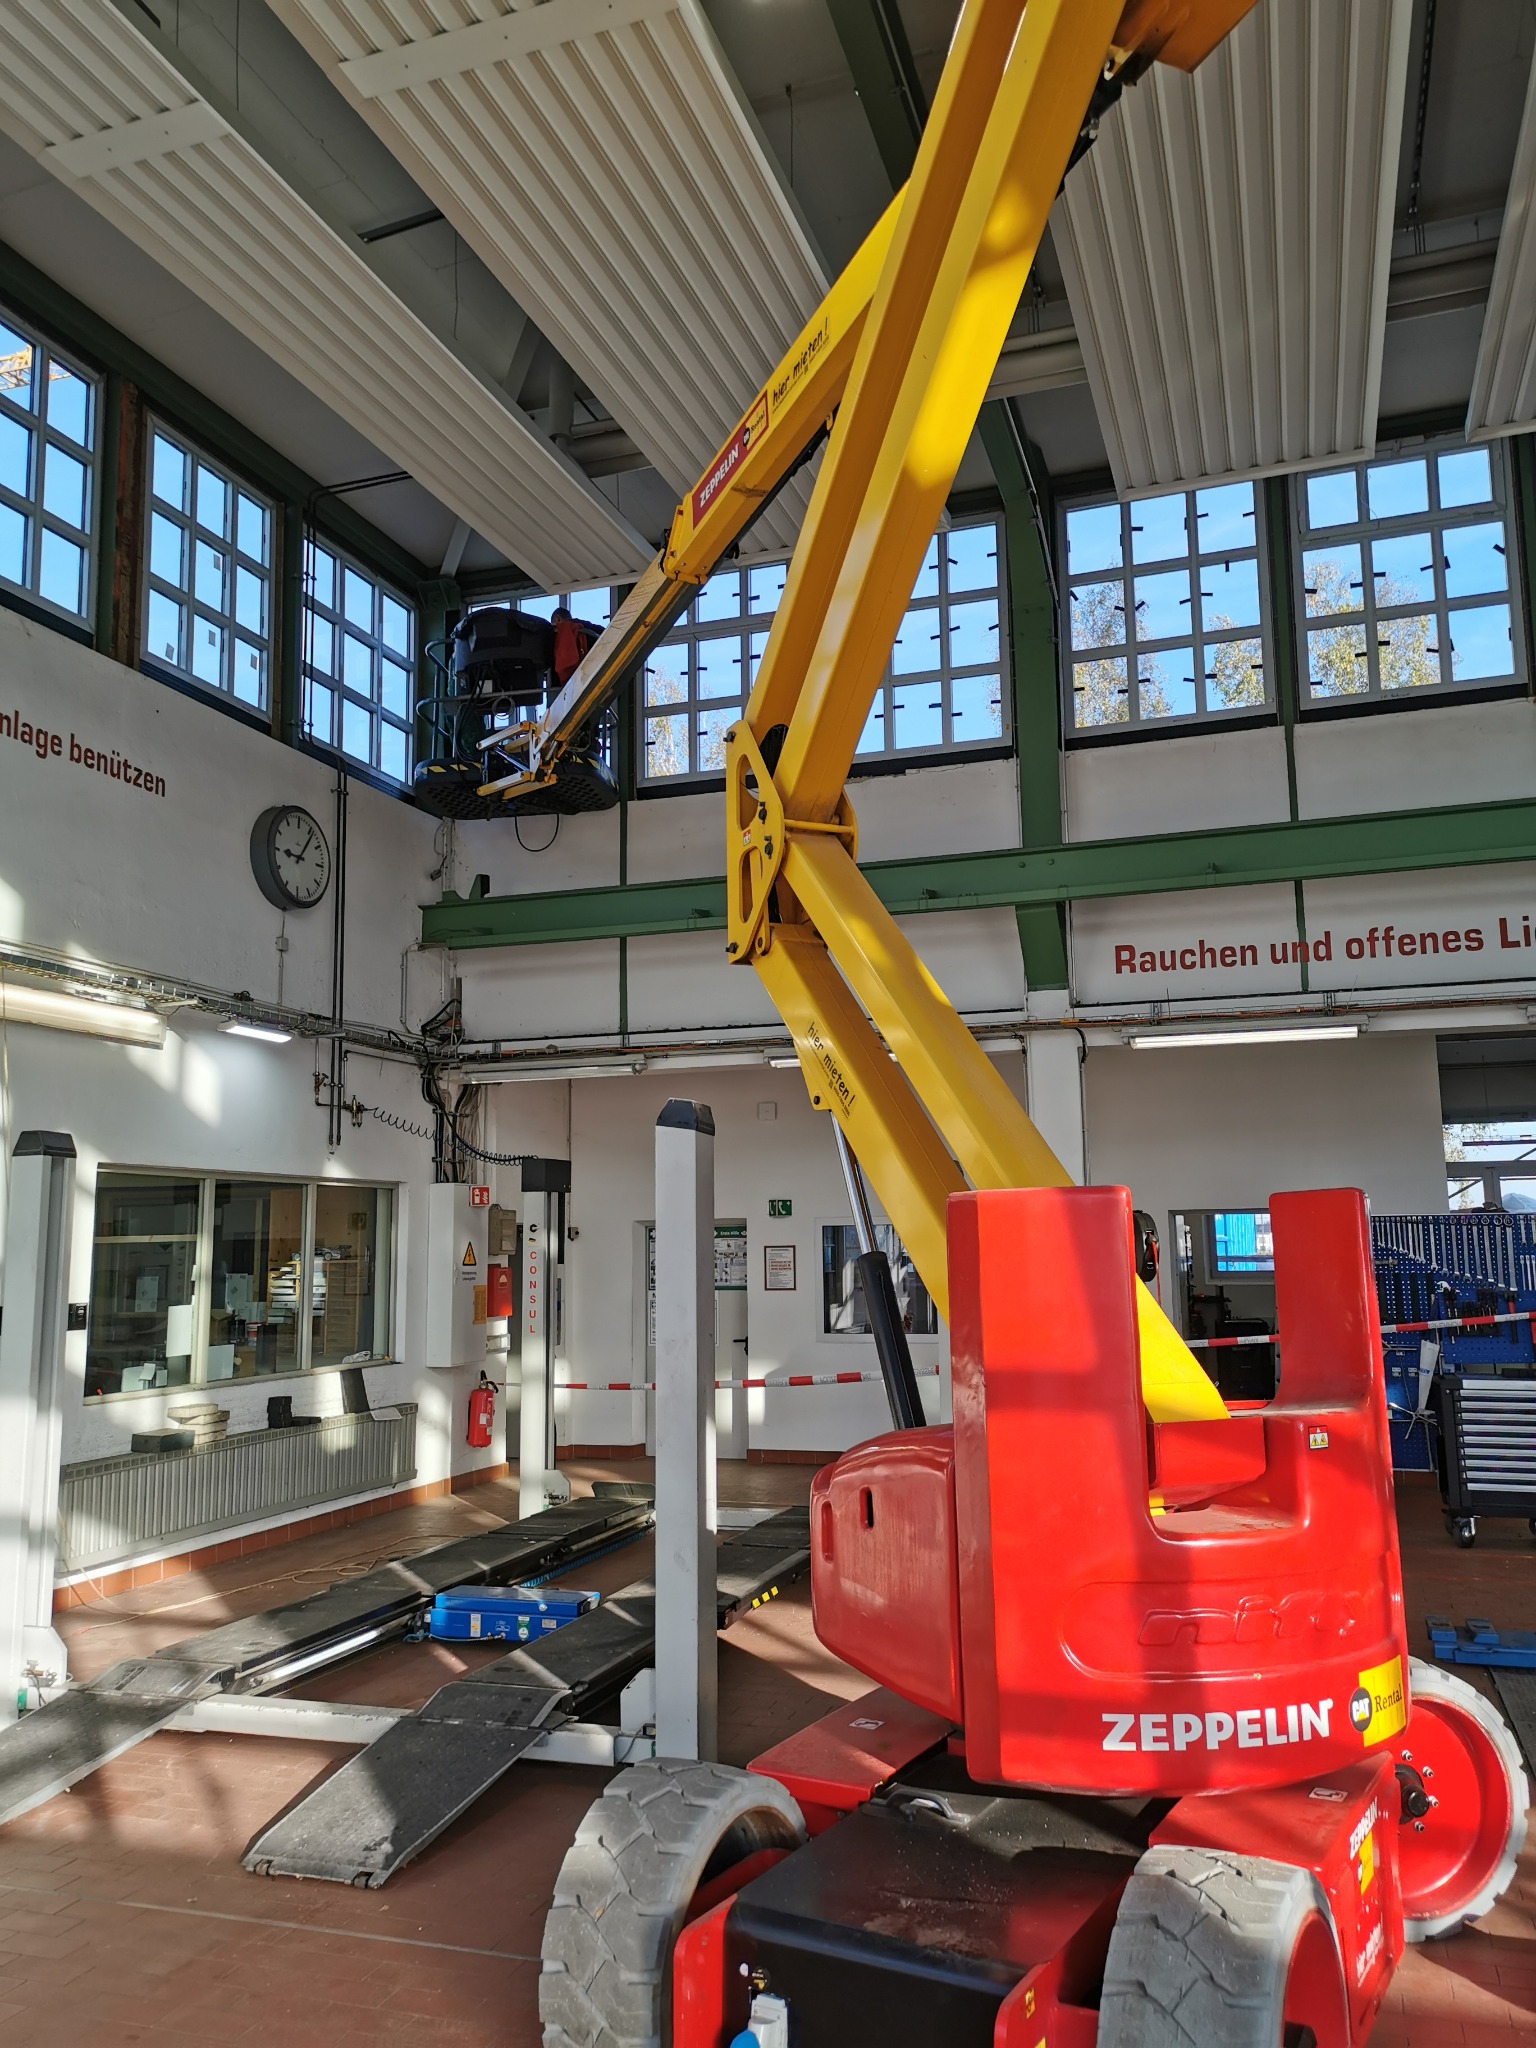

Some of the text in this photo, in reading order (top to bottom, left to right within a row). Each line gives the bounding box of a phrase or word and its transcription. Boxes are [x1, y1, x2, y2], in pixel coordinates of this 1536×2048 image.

[773, 375, 790, 407] hier
[700, 441, 740, 508] ZEPPELIN
[69, 733, 166, 797] benützen
[1114, 915, 1536, 974] Rauchen und offenes Li
[807, 1021, 824, 1051] hier
[529, 1251, 537, 1333] CONSUL
[1102, 1698, 1333, 1752] ZEPPELIN
[1352, 1697, 1370, 1723] CAT
[1374, 1683, 1403, 1713] Rental
[1349, 1795, 1378, 1861] ZEPPELIN
